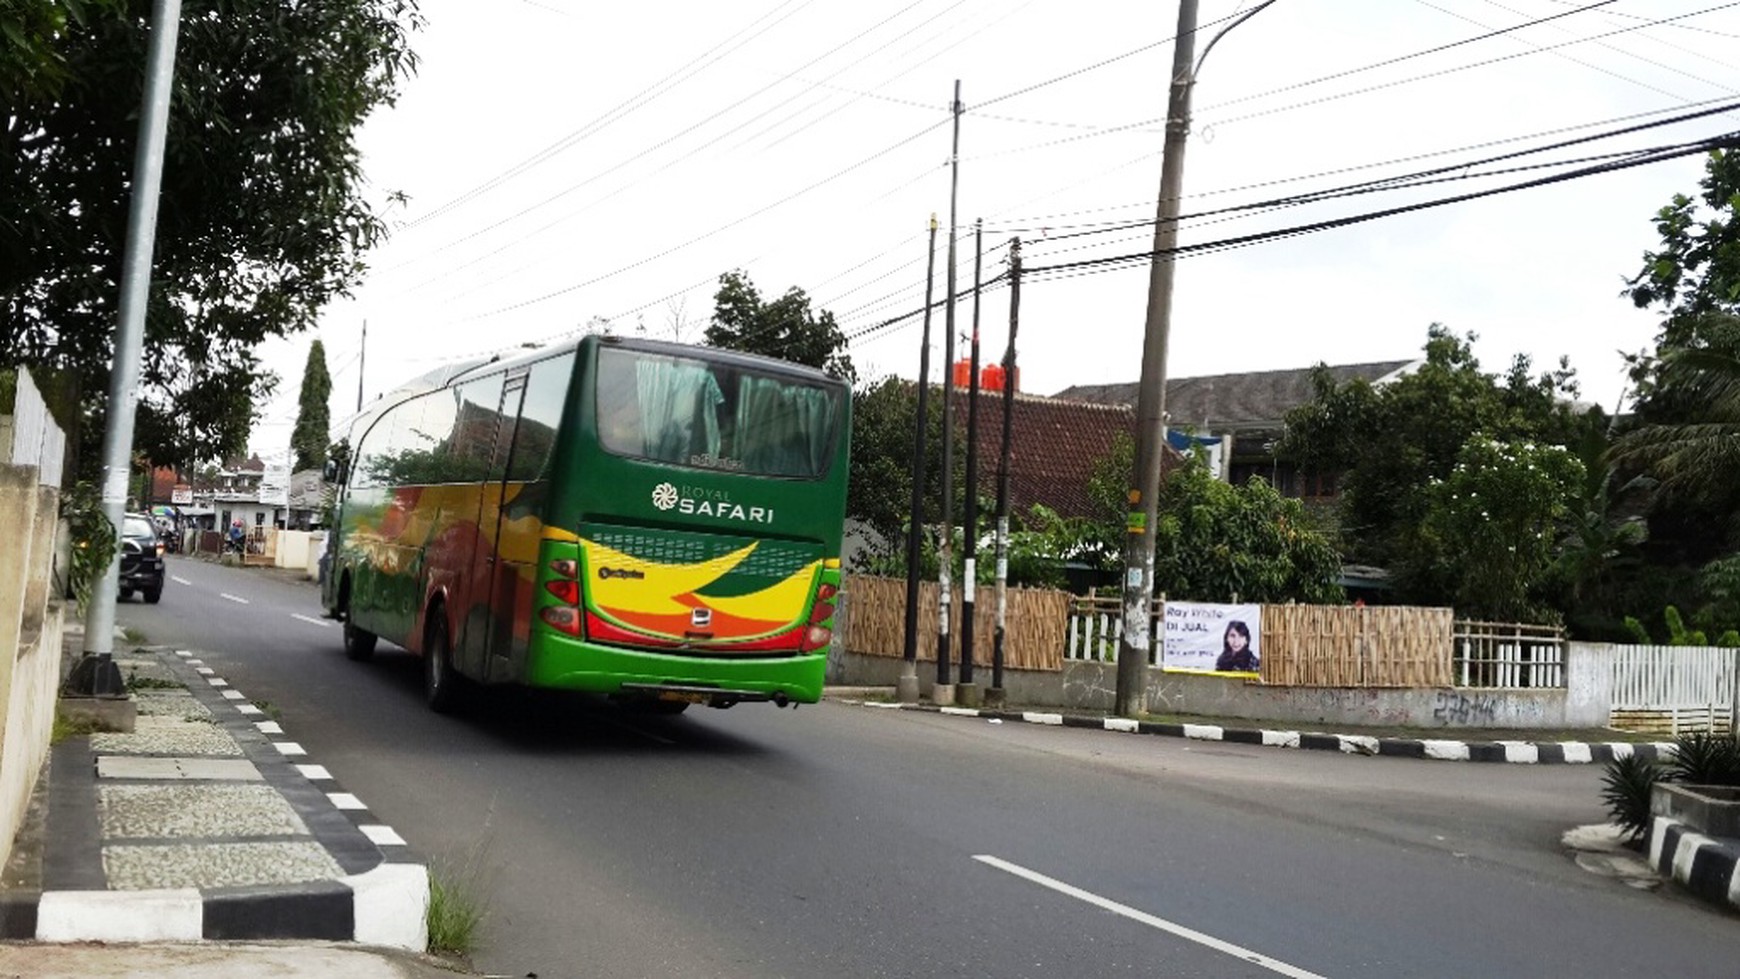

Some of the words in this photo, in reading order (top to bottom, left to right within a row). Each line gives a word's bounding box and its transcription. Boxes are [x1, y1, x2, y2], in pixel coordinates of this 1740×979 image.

[682, 486, 731, 501] ROYAL
[679, 498, 774, 524] SAFARI
[1167, 606, 1188, 618] Ray
[1167, 622, 1178, 631] DI
[1181, 623, 1209, 632] JUAL
